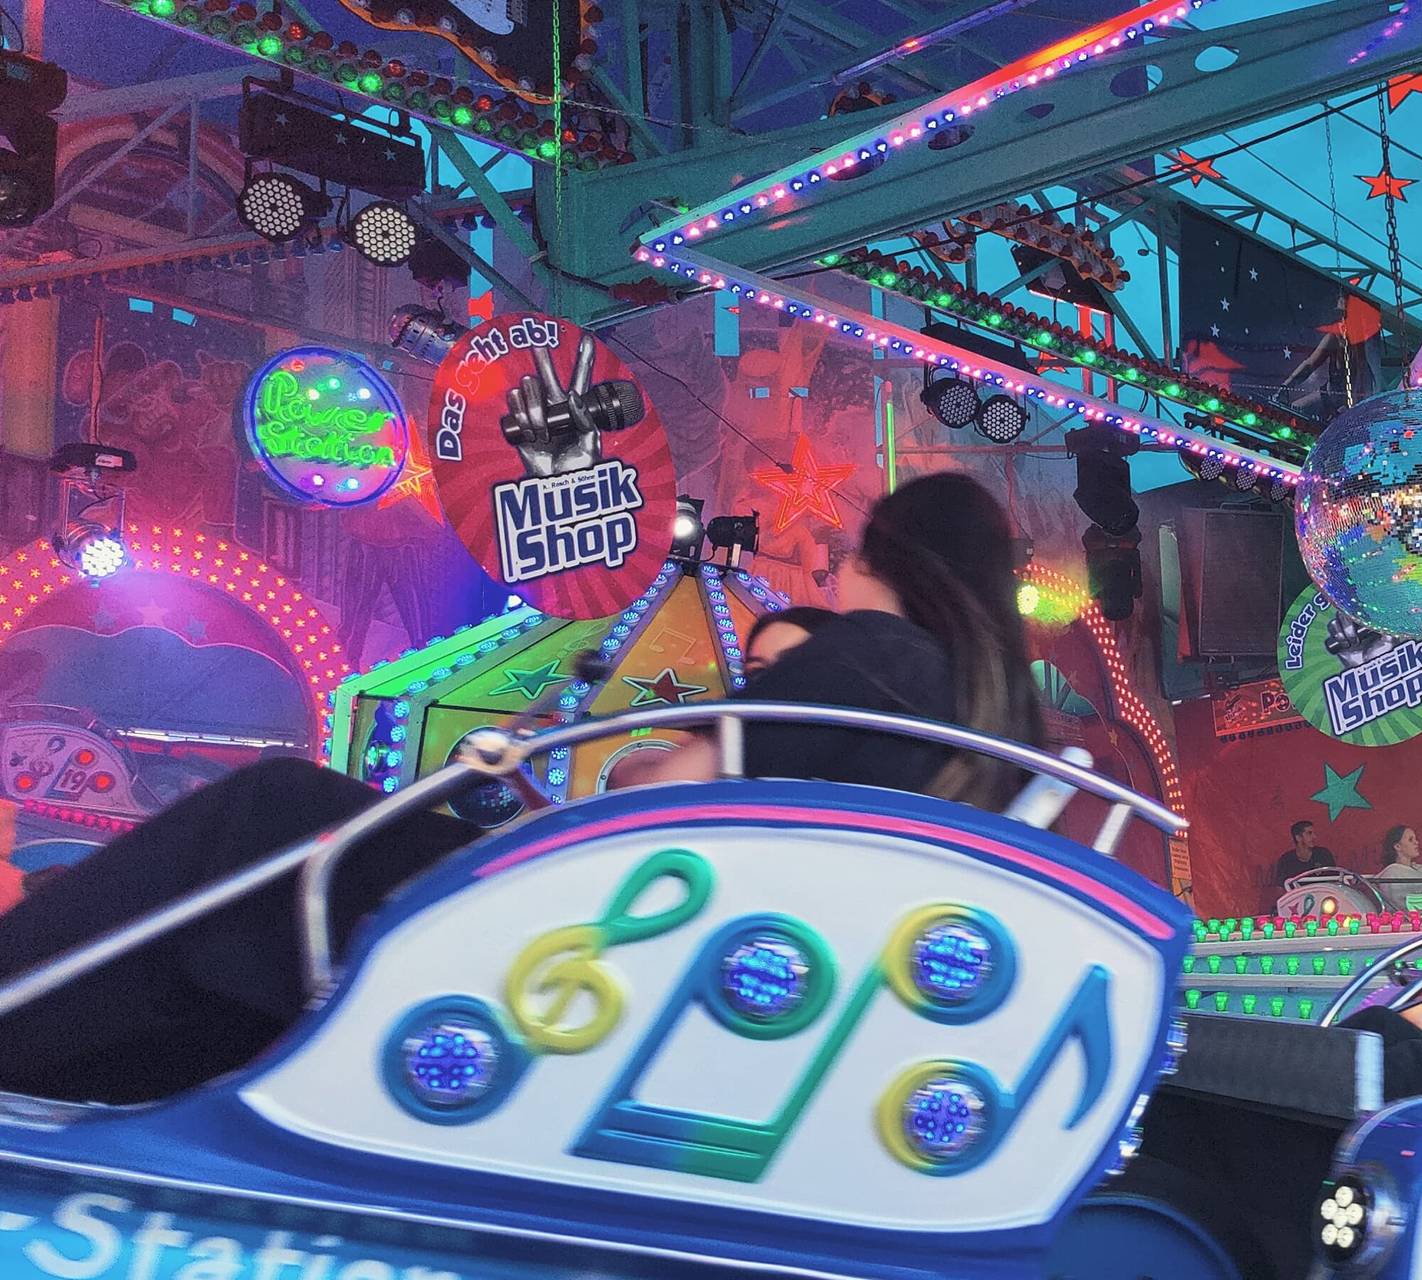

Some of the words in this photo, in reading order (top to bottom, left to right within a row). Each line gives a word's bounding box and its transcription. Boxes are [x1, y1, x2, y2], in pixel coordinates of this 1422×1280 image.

[264, 371, 394, 434] Power
[436, 387, 466, 461] Das
[508, 317, 560, 350] ab!
[258, 421, 396, 467] Station
[498, 462, 641, 533] Musik
[1286, 604, 1317, 669] Leider
